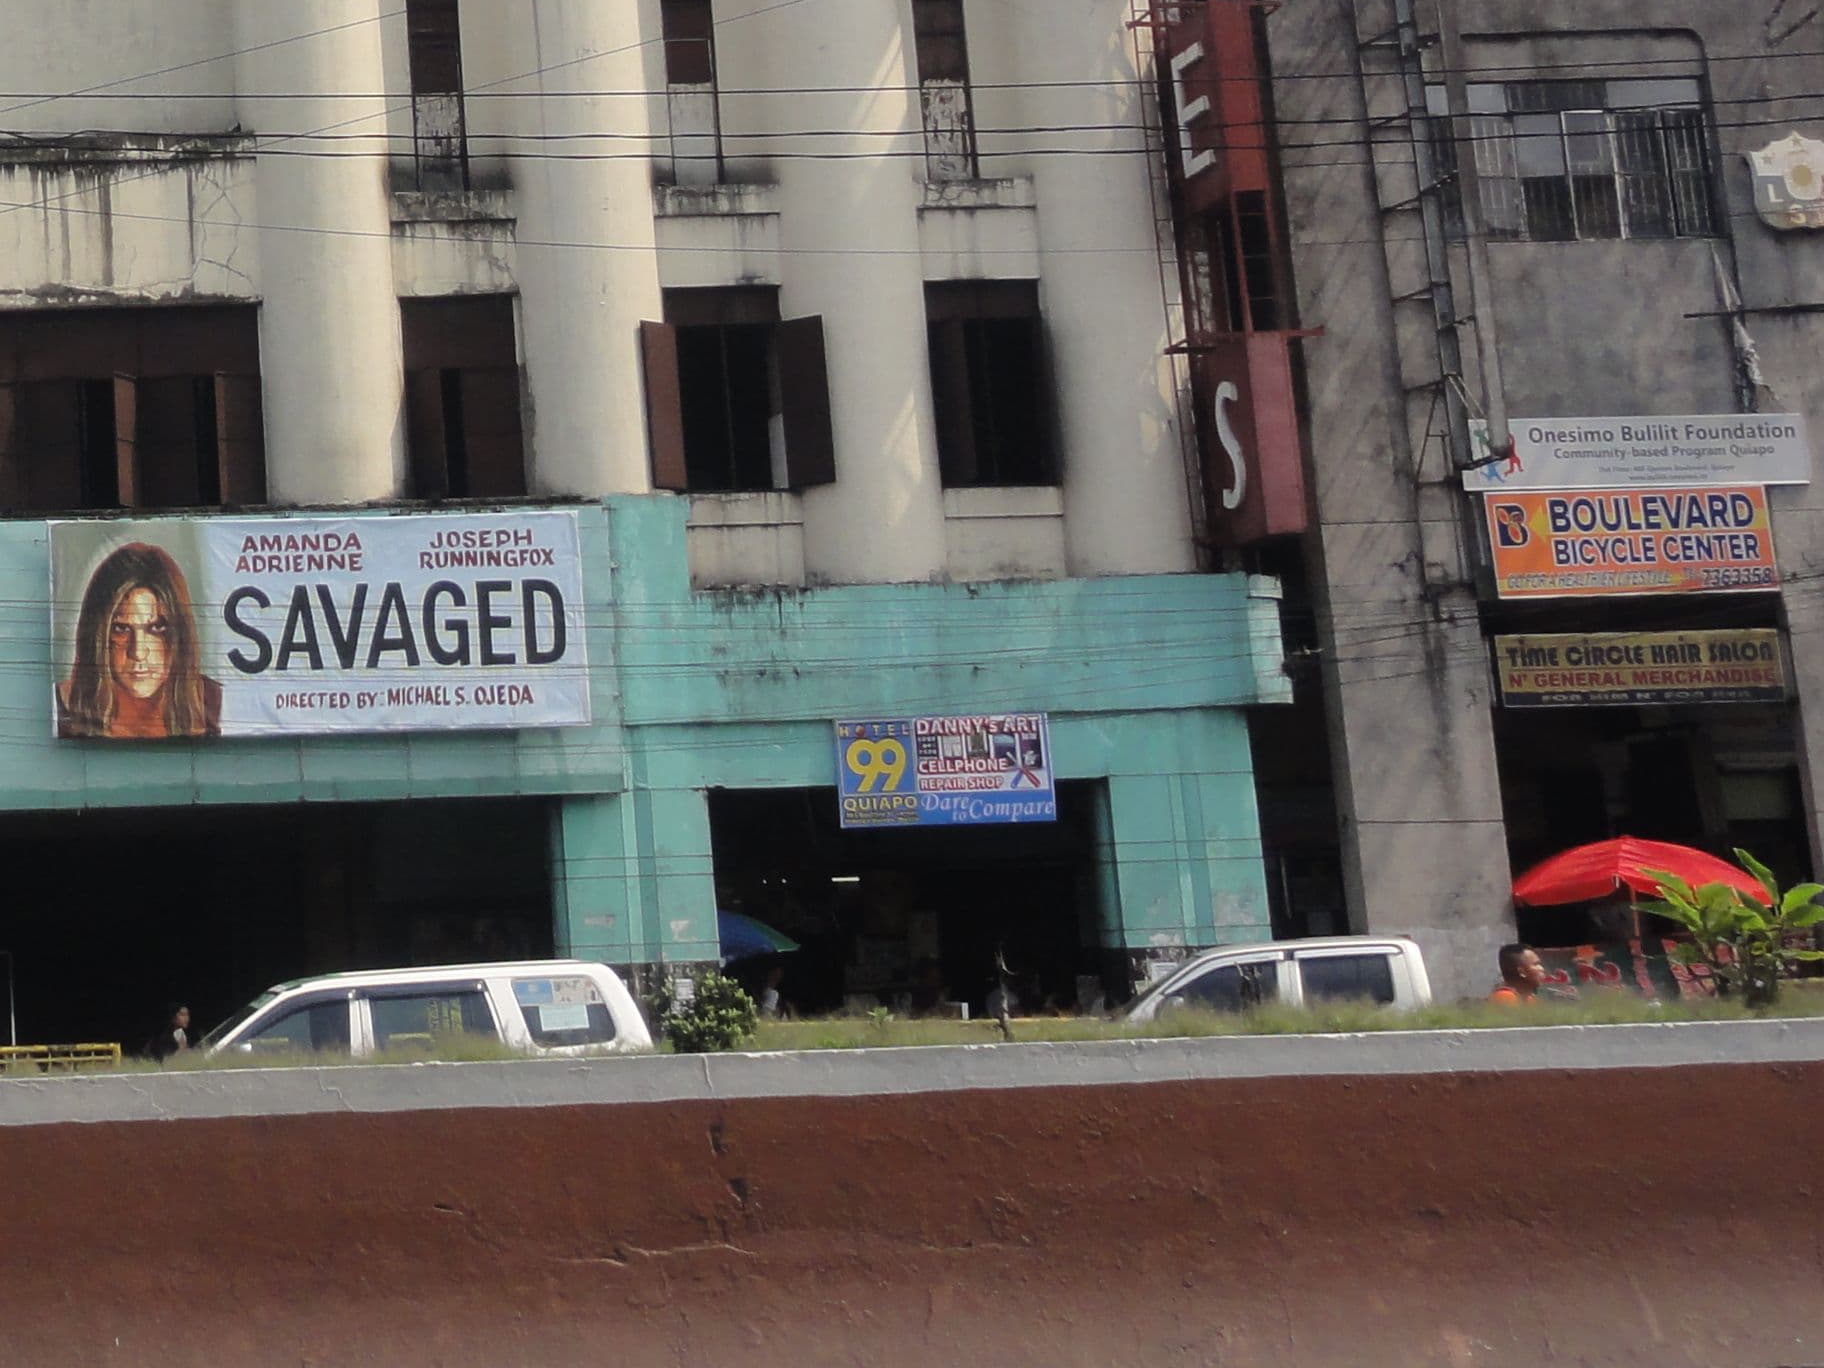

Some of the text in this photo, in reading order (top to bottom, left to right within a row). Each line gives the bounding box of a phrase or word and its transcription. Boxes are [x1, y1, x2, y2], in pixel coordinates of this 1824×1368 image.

[1528, 422, 1796, 444] Onesimo Bulilit Foundation
[1672, 444, 1726, 460] Program
[1730, 443, 1775, 457] Quiapo
[1547, 493, 1755, 533] BOULEVARD
[241, 532, 363, 553] AMANDA
[429, 528, 534, 549] JOSEPH
[1554, 533, 1760, 566] BICYCLE CENTER
[234, 552, 364, 574] ADRIENNE
[419, 548, 555, 570] RUNNINGFOX
[223, 578, 568, 675] SAVAGED
[1534, 671, 1627, 688] GENERAL
[1633, 666, 1777, 686] MERCHANDISE
[275, 691, 351, 710] DIRECTED
[474, 683, 535, 707] OJEDA
[916, 715, 1041, 735] DANNY's ART
[845, 737, 906, 793] 99
[918, 757, 1008, 775] CELLPHONE
[920, 775, 1005, 791] REPAIR SHOP
[843, 795, 919, 812] QUIAPO
[920, 793, 1055, 822] Dare to Compare
